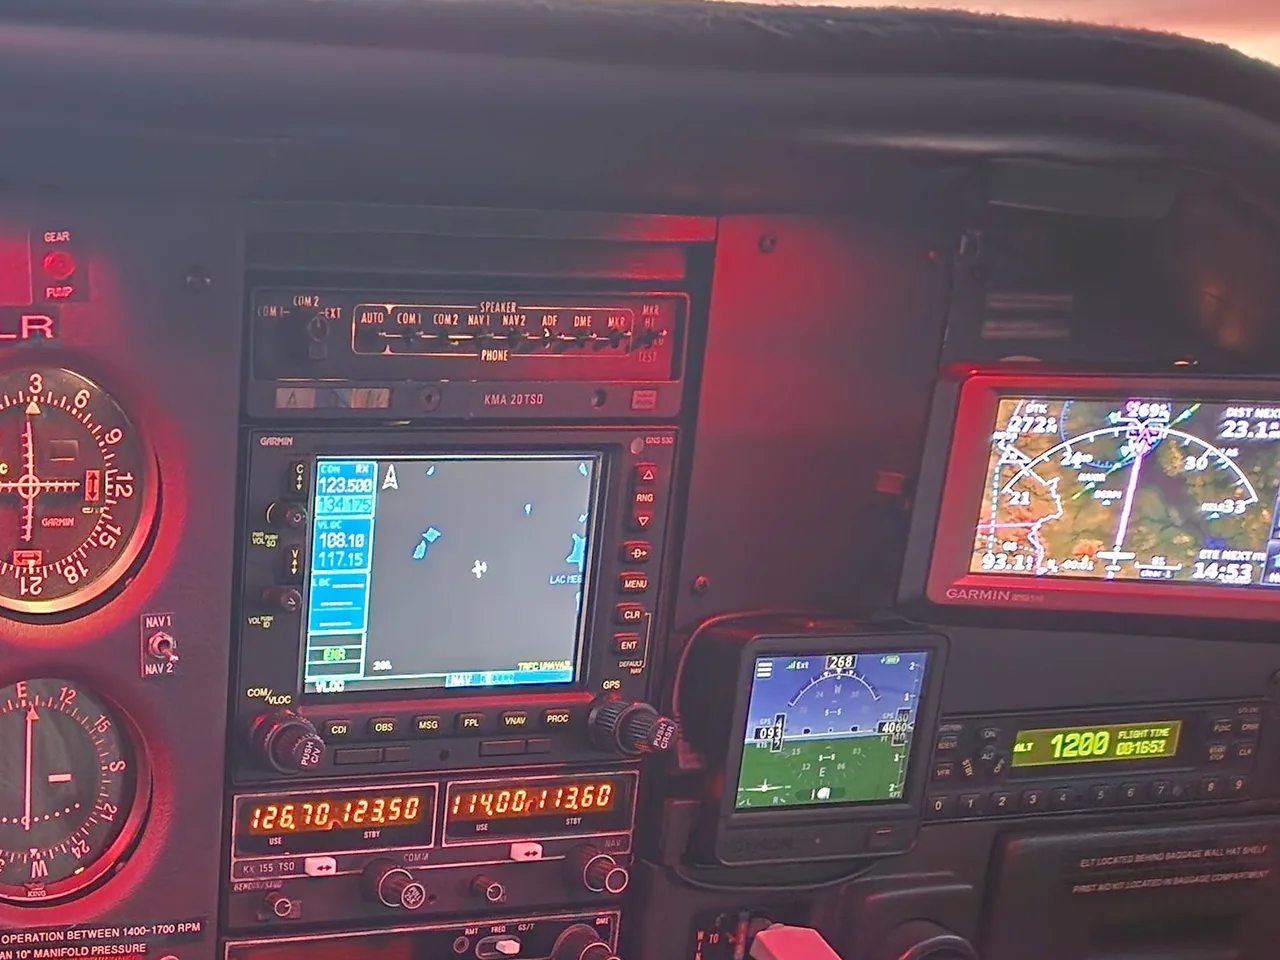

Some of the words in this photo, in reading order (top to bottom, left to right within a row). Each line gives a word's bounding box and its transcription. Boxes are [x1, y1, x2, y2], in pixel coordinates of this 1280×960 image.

[44, 231, 70, 242] GEAR
[46, 287, 73, 298] PUMP
[480, 302, 517, 314] SPEAKER
[361, 312, 384, 324] AUTO
[541, 315, 558, 326] ADF
[574, 315, 592, 327] DME
[481, 349, 508, 361] PHONE
[484, 394, 507, 405] KMA
[1226, 408, 1253, 419] DIST
[260, 437, 294, 446] GARMIN
[1184, 456, 1208, 470] 30
[115, 472, 134, 498] 12
[319, 477, 372, 493] 123.500
[636, 493, 654, 503] RNG
[41, 517, 74, 528] GARMIN
[99, 524, 122, 549] 15
[319, 532, 364, 548] 108.10
[319, 551, 363, 567] 117.15
[1222, 550, 1252, 561] NEXT
[63, 561, 89, 584] 18
[1193, 562, 1253, 580] 14:53
[20, 576, 43, 596] 21
[624, 578, 648, 589] MENU
[946, 588, 1010, 600] GARMIN
[624, 610, 641, 619] CLR
[621, 641, 637, 650] ENT
[829, 657, 854, 668] 268
[602, 680, 620, 690] GPS
[464, 718, 480, 727] FPL
[505, 716, 526, 726] VNAV
[547, 714, 569, 723] PROC
[331, 725, 347, 735] CDI
[375, 723, 393, 732] OBS
[419, 720, 438, 730] MSG
[1118, 730, 1148, 739] FLIGHT
[1150, 727, 1171, 738] TIME
[1050, 731, 1110, 758] 1200
[453, 790, 526, 816] 114.00
[539, 784, 611, 810] 113.60
[253, 802, 330, 829] 126.70
[343, 797, 419, 823] 123.50
[364, 830, 380, 839] STBY
[259, 863, 274, 873] 155
[279, 861, 295, 871] TSO
[0, 930, 64, 944] OPERATION
[67, 927, 120, 940] BETWEEN
[122, 923, 175, 936] 1400-1700
[178, 922, 201, 933] RPM
[33, 946, 89, 959] MANIFOLD
[91, 943, 146, 955] PRESSURE
